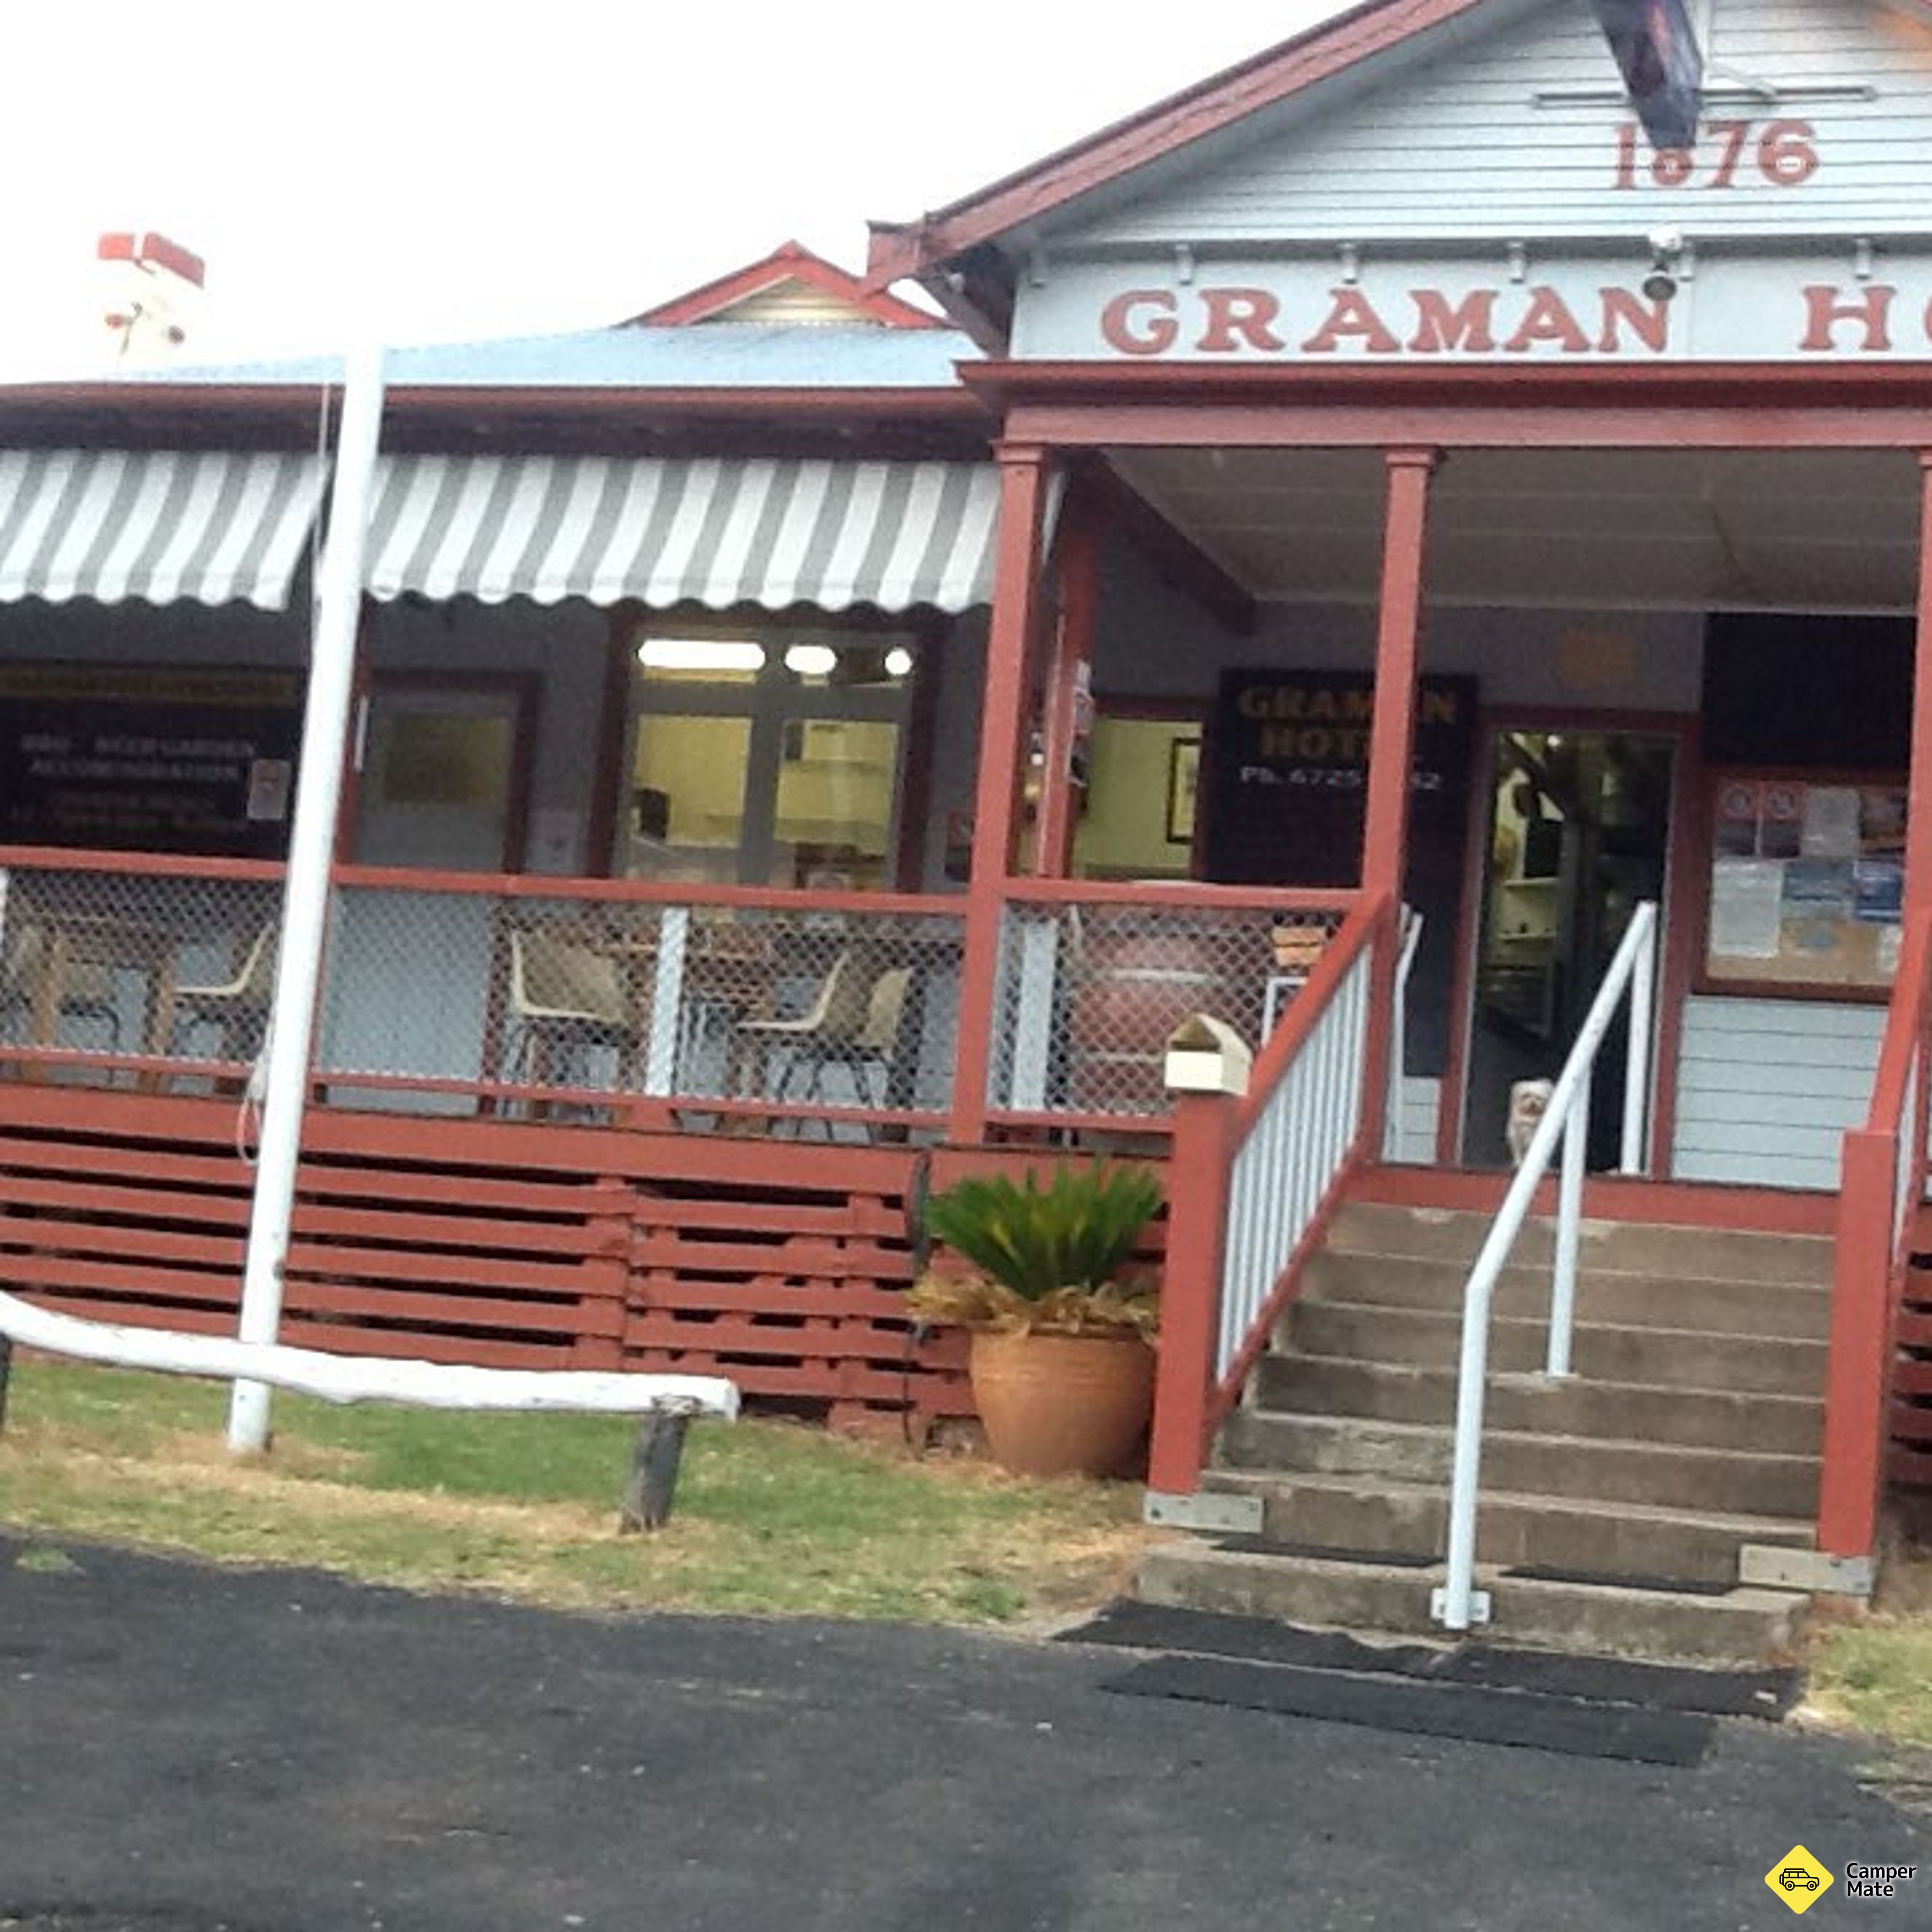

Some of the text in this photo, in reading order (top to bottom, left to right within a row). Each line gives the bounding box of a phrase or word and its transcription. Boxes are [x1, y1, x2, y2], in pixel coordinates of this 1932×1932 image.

[1612, 119, 1819, 190] 1876
[1101, 285, 1932, 355] GRAMAN H
[1238, 686, 1455, 723] GRAMN
